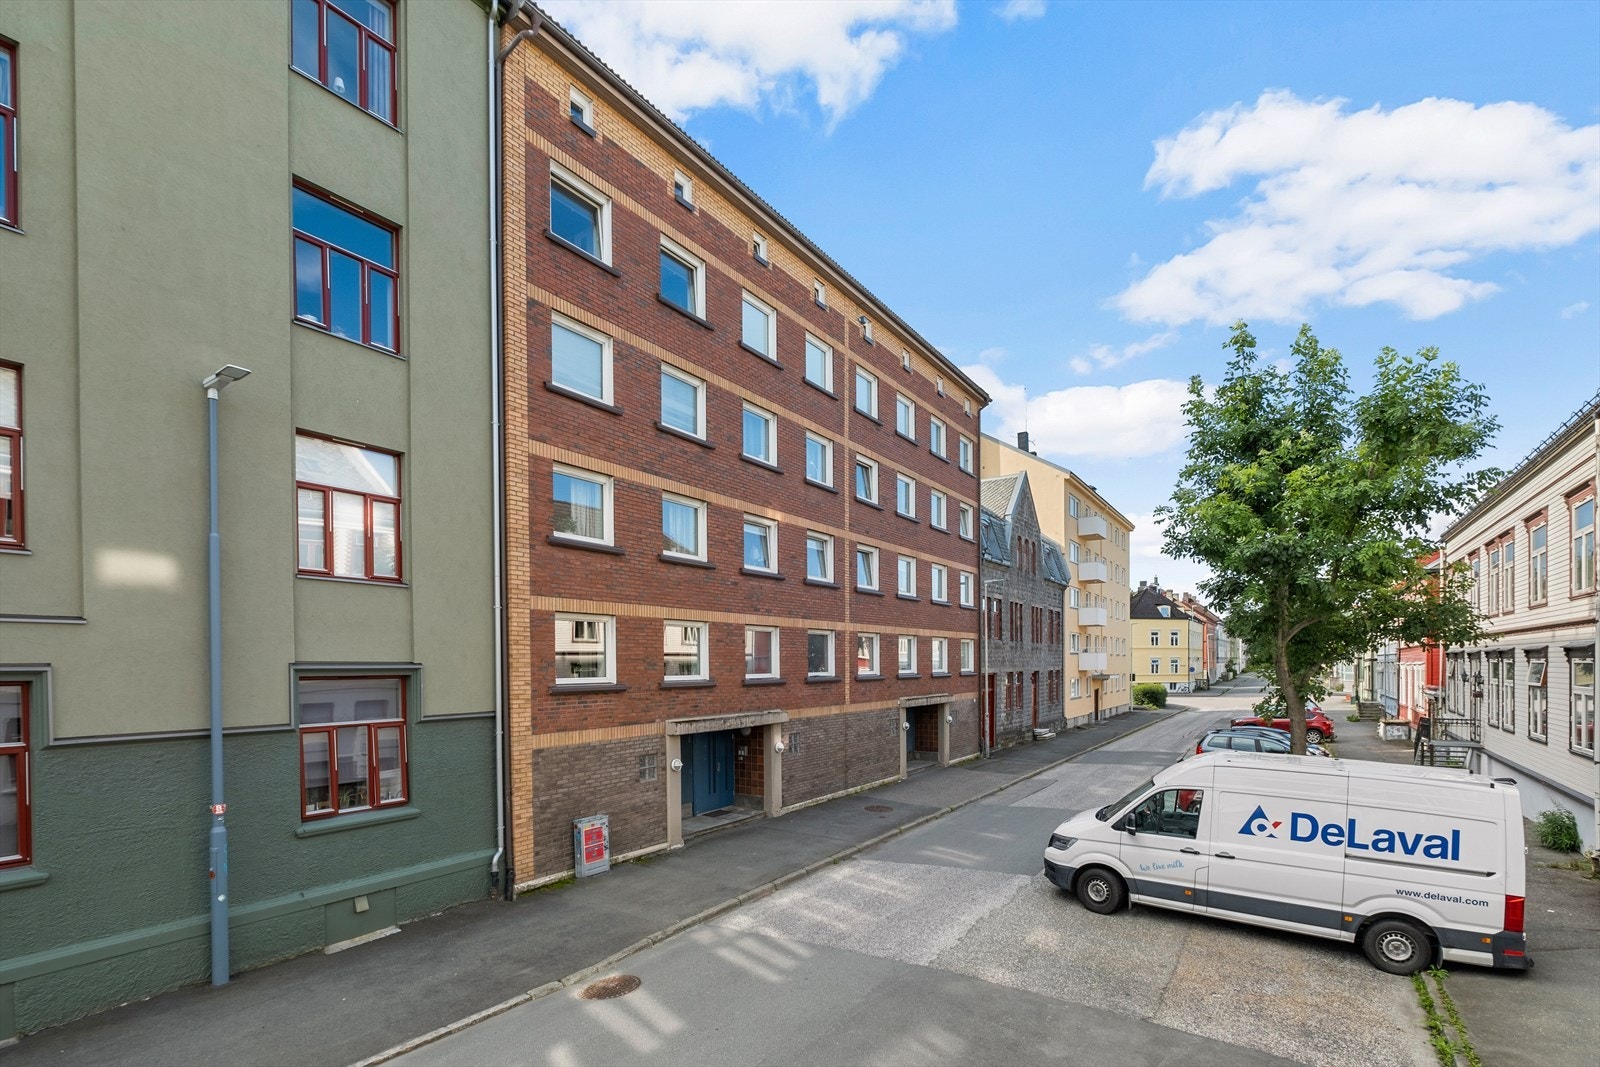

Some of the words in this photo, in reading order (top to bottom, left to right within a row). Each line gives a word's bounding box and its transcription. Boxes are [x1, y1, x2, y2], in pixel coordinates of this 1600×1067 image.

[1290, 811, 1461, 861] DeLaval
[1139, 863, 1151, 871] We
[1152, 862, 1166, 870] live
[1167, 859, 1184, 869] milk
[1395, 888, 1489, 907] www.delaval.com
